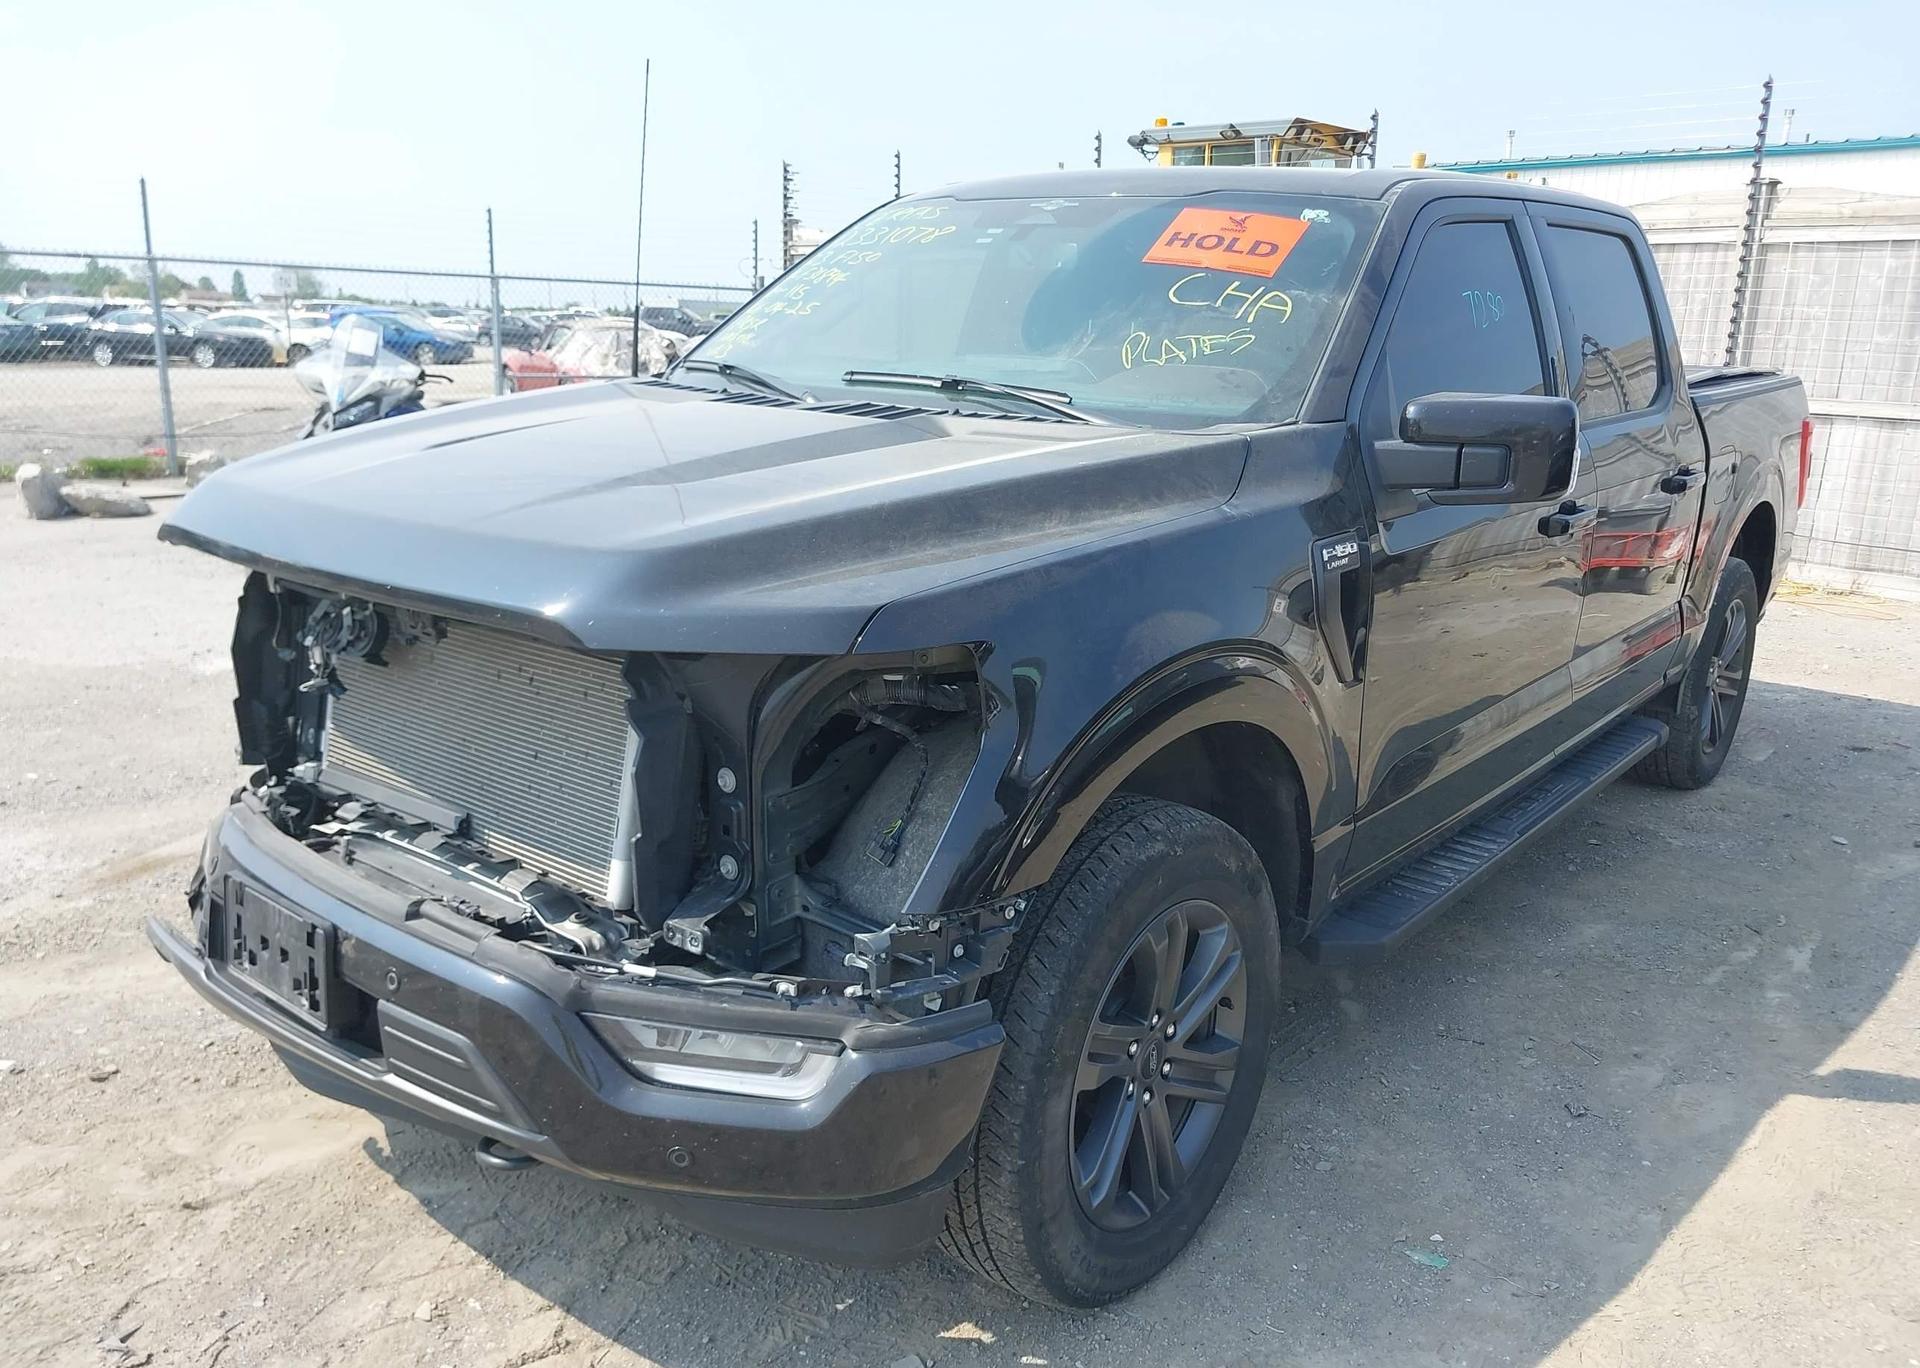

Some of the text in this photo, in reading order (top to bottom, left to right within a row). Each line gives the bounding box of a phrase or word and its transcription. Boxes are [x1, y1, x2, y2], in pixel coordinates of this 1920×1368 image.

[1164, 231, 1280, 258] HOLD
[1168, 273, 1293, 324] CHA
[1121, 329, 1255, 369] PLATES
[1322, 542, 1358, 561] F-150
[1327, 557, 1349, 570] LARIAT
